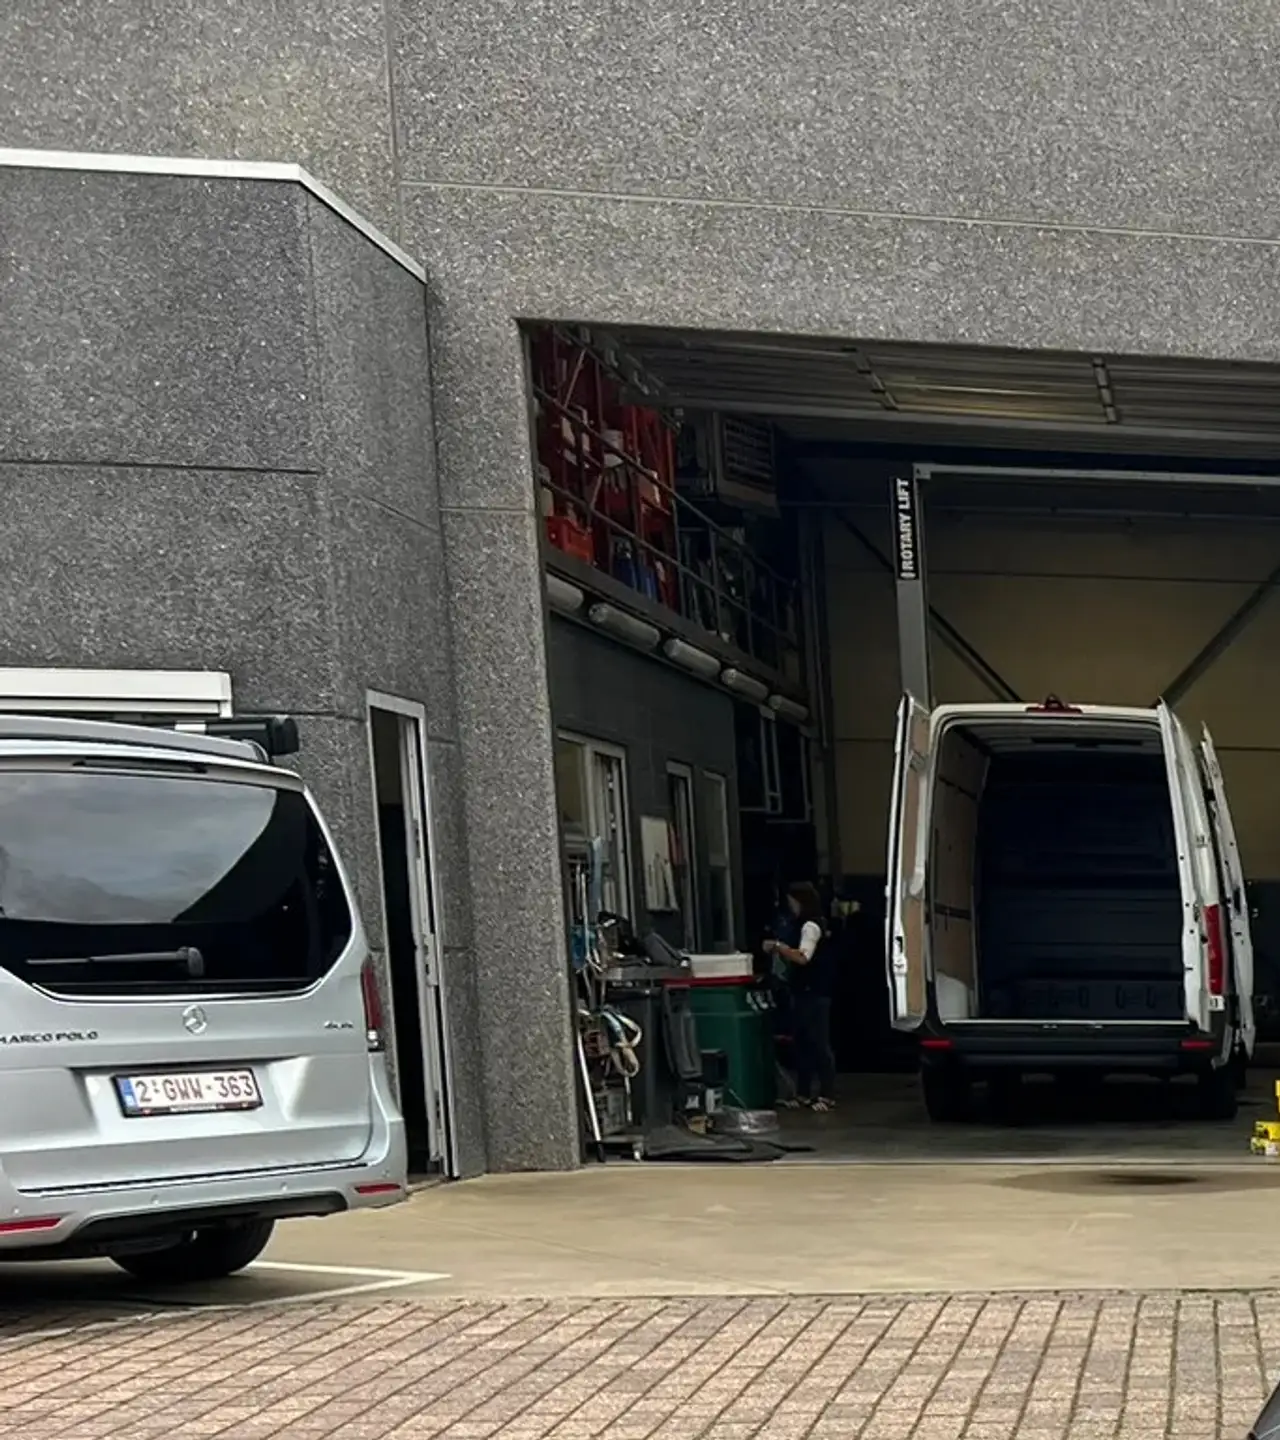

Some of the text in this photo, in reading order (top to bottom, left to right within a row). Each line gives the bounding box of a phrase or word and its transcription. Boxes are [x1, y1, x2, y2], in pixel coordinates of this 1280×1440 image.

[896, 478, 915, 571] ROTARY LIFT
[55, 1030, 98, 1042] POLO
